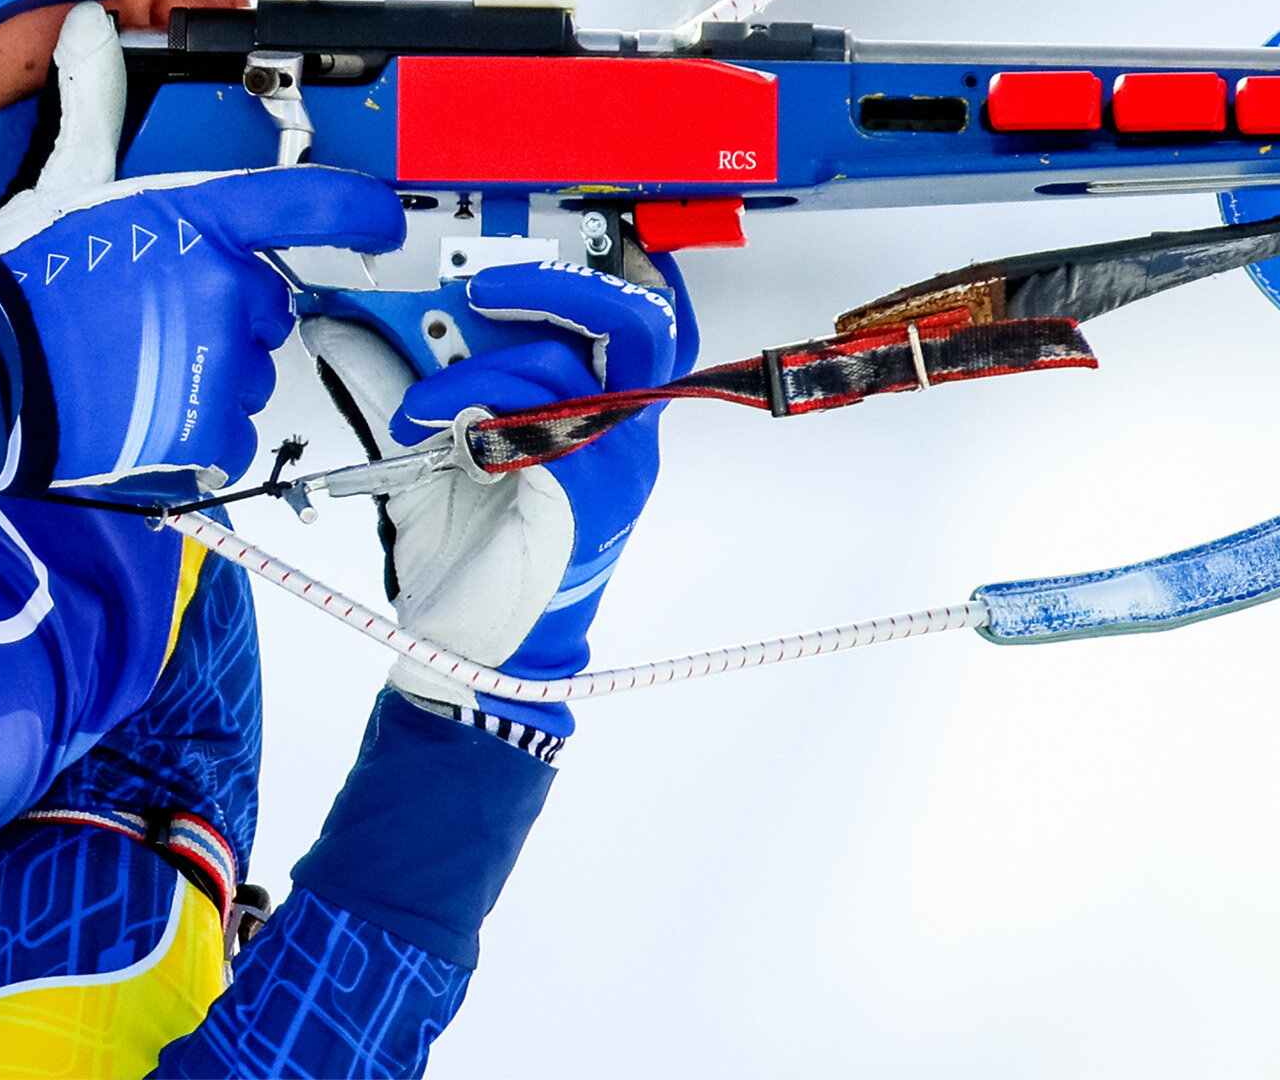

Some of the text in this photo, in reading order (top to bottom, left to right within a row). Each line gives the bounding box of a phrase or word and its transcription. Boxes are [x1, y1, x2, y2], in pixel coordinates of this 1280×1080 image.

[718, 150, 757, 170] RCS
[180, 345, 209, 442] Legend Slim
